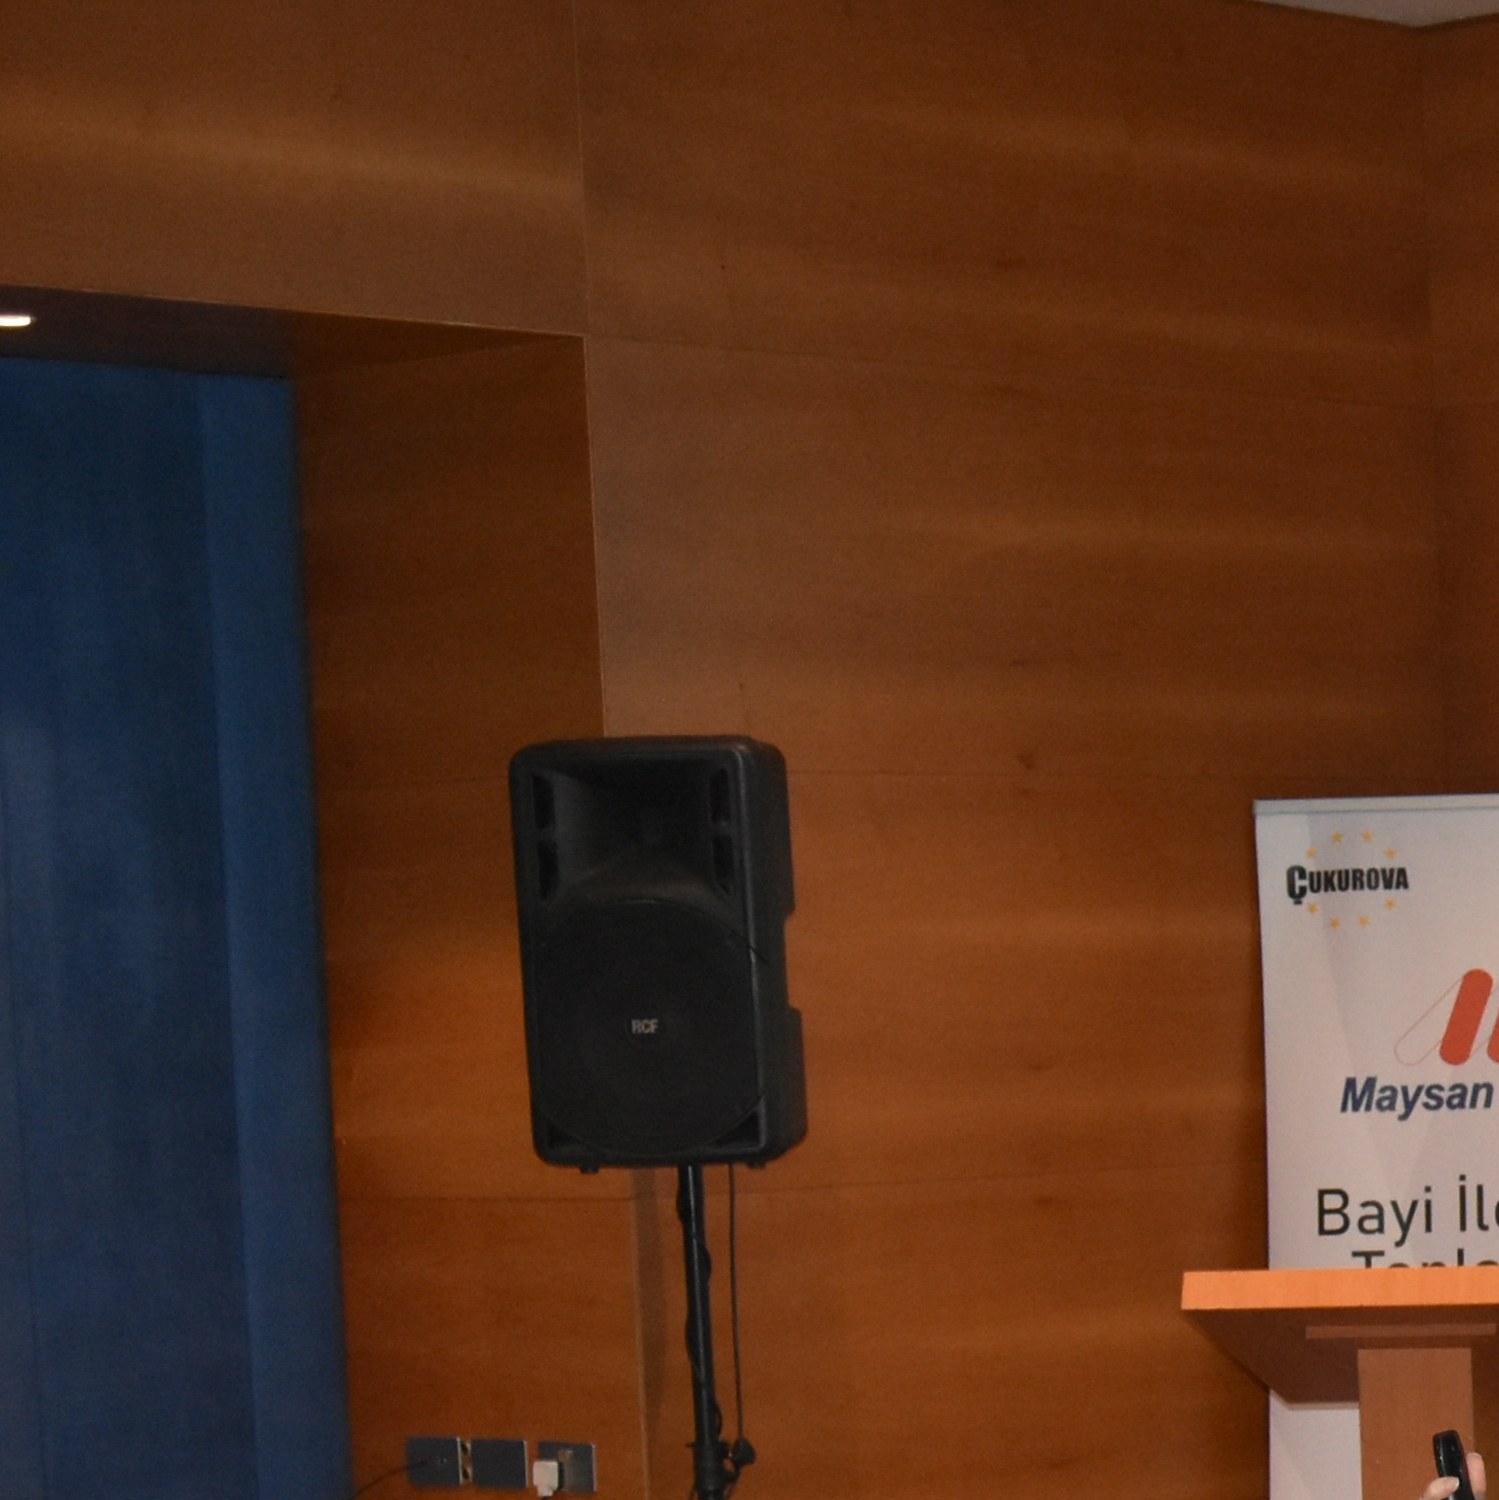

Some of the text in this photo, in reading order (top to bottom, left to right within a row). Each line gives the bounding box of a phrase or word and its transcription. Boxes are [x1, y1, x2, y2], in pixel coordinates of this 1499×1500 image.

[1286, 865, 1410, 905] ÇUKUROVA
[631, 1018, 659, 1034] RCF
[1340, 1076, 1495, 1121] Maysan
[1316, 1186, 1434, 1247] Bayi
